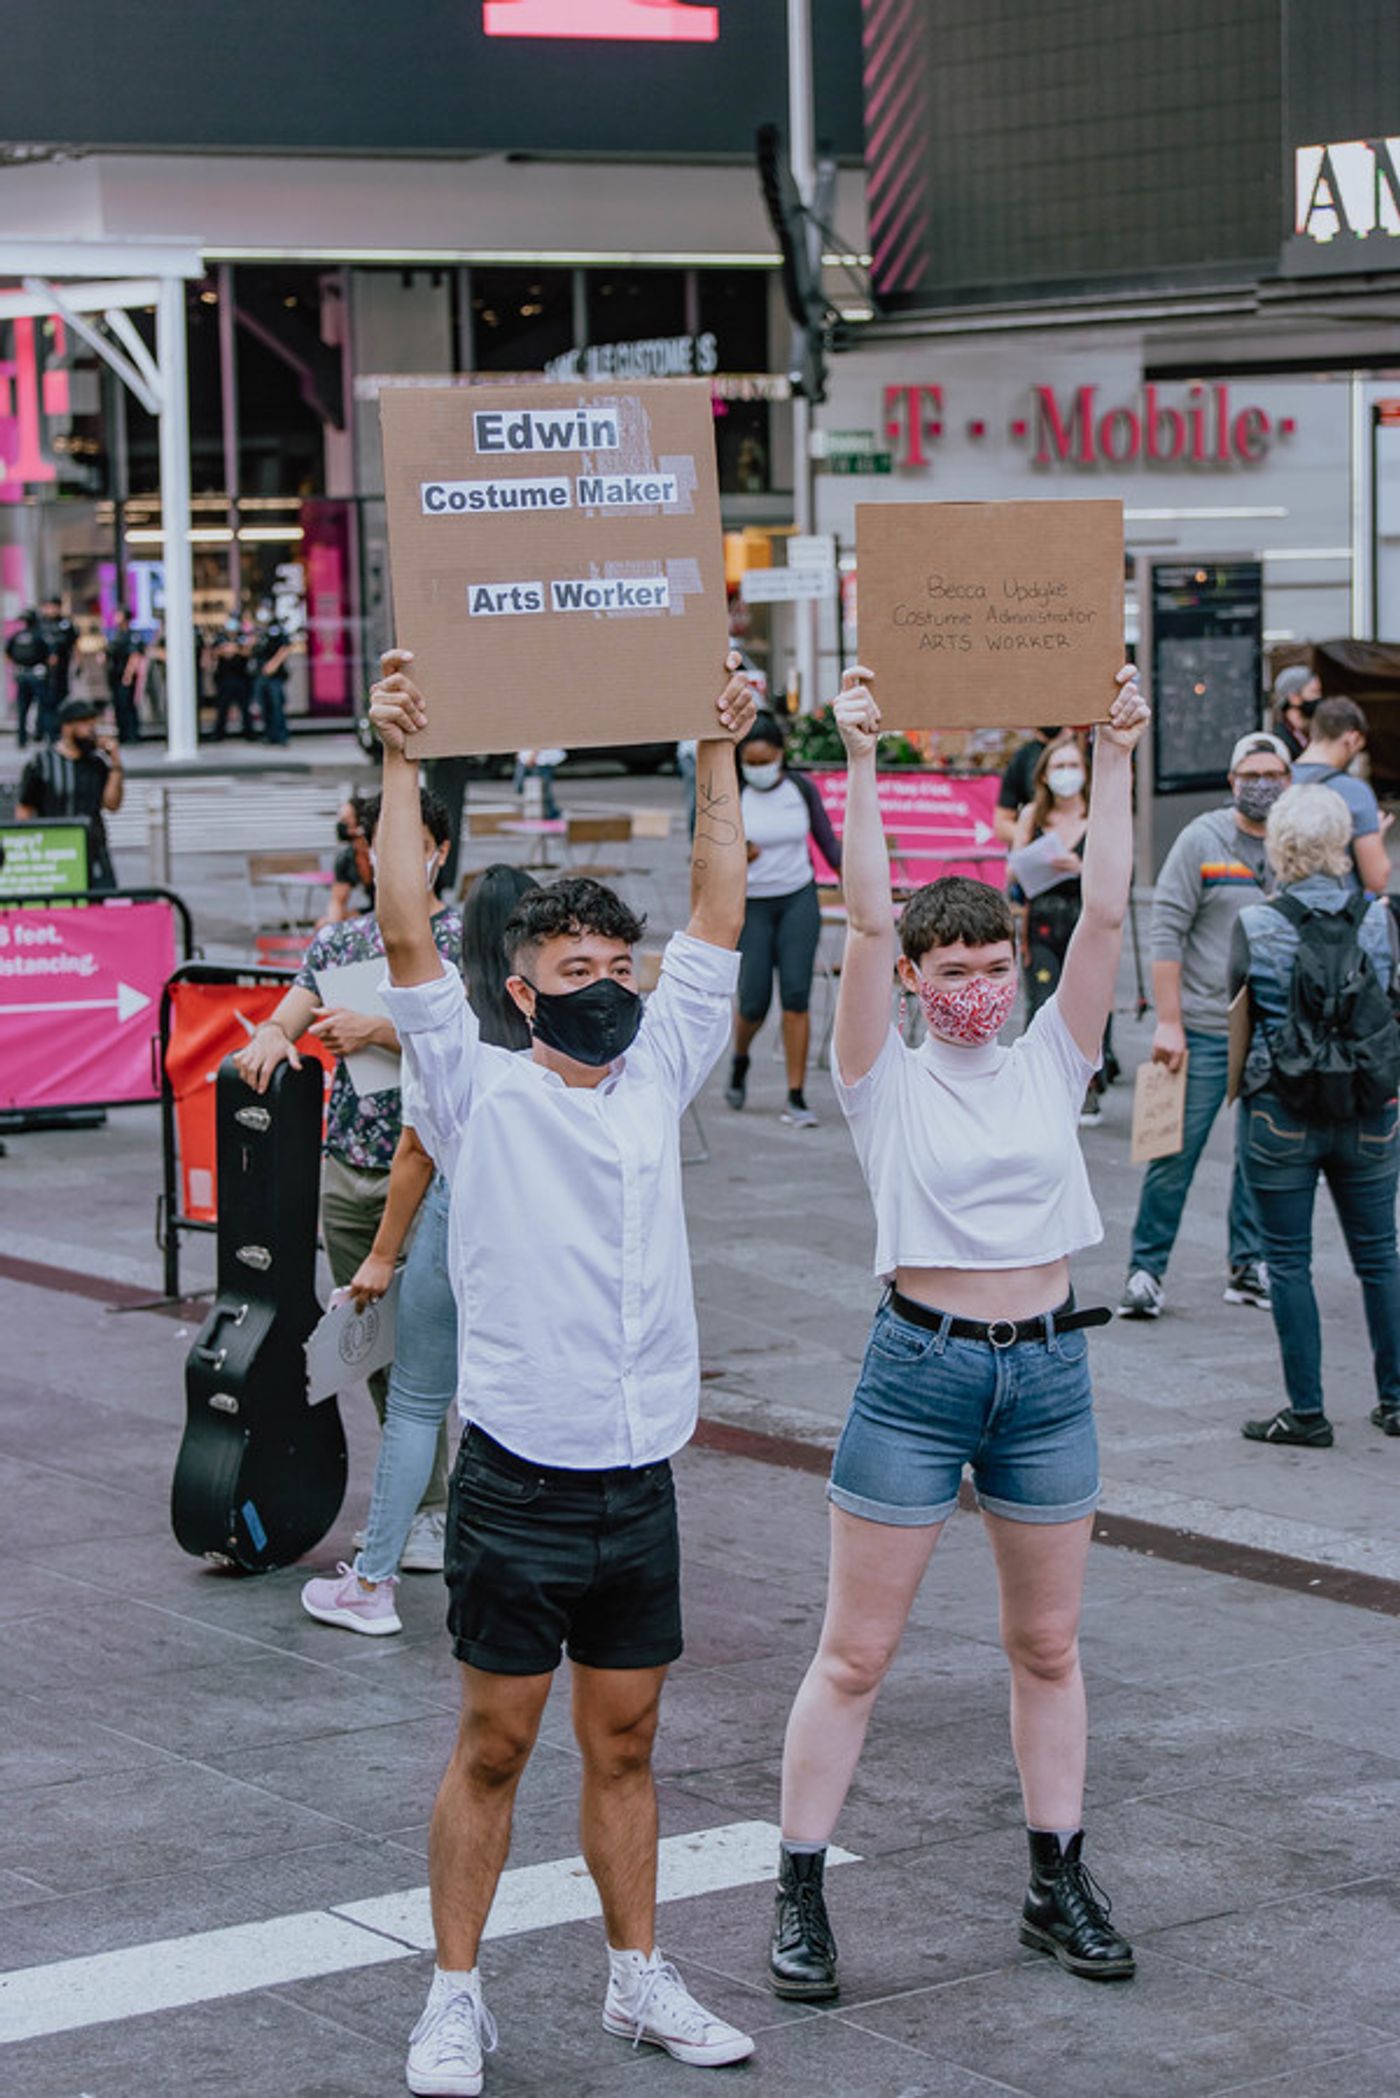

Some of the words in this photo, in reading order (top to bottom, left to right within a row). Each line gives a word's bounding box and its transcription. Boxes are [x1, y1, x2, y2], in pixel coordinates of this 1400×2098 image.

[475, 412, 617, 451] Edwin
[424, 484, 567, 512] Costume
[578, 478, 674, 504] Maker
[472, 587, 541, 613] Arts
[553, 582, 666, 608] Worker
[927, 574, 986, 599] Becca
[1003, 578, 1068, 607] Updyke
[893, 604, 972, 626] Costume
[986, 605, 1096, 625] Administrator
[919, 633, 973, 651] ARTS
[985, 634, 1071, 651] WORKER
